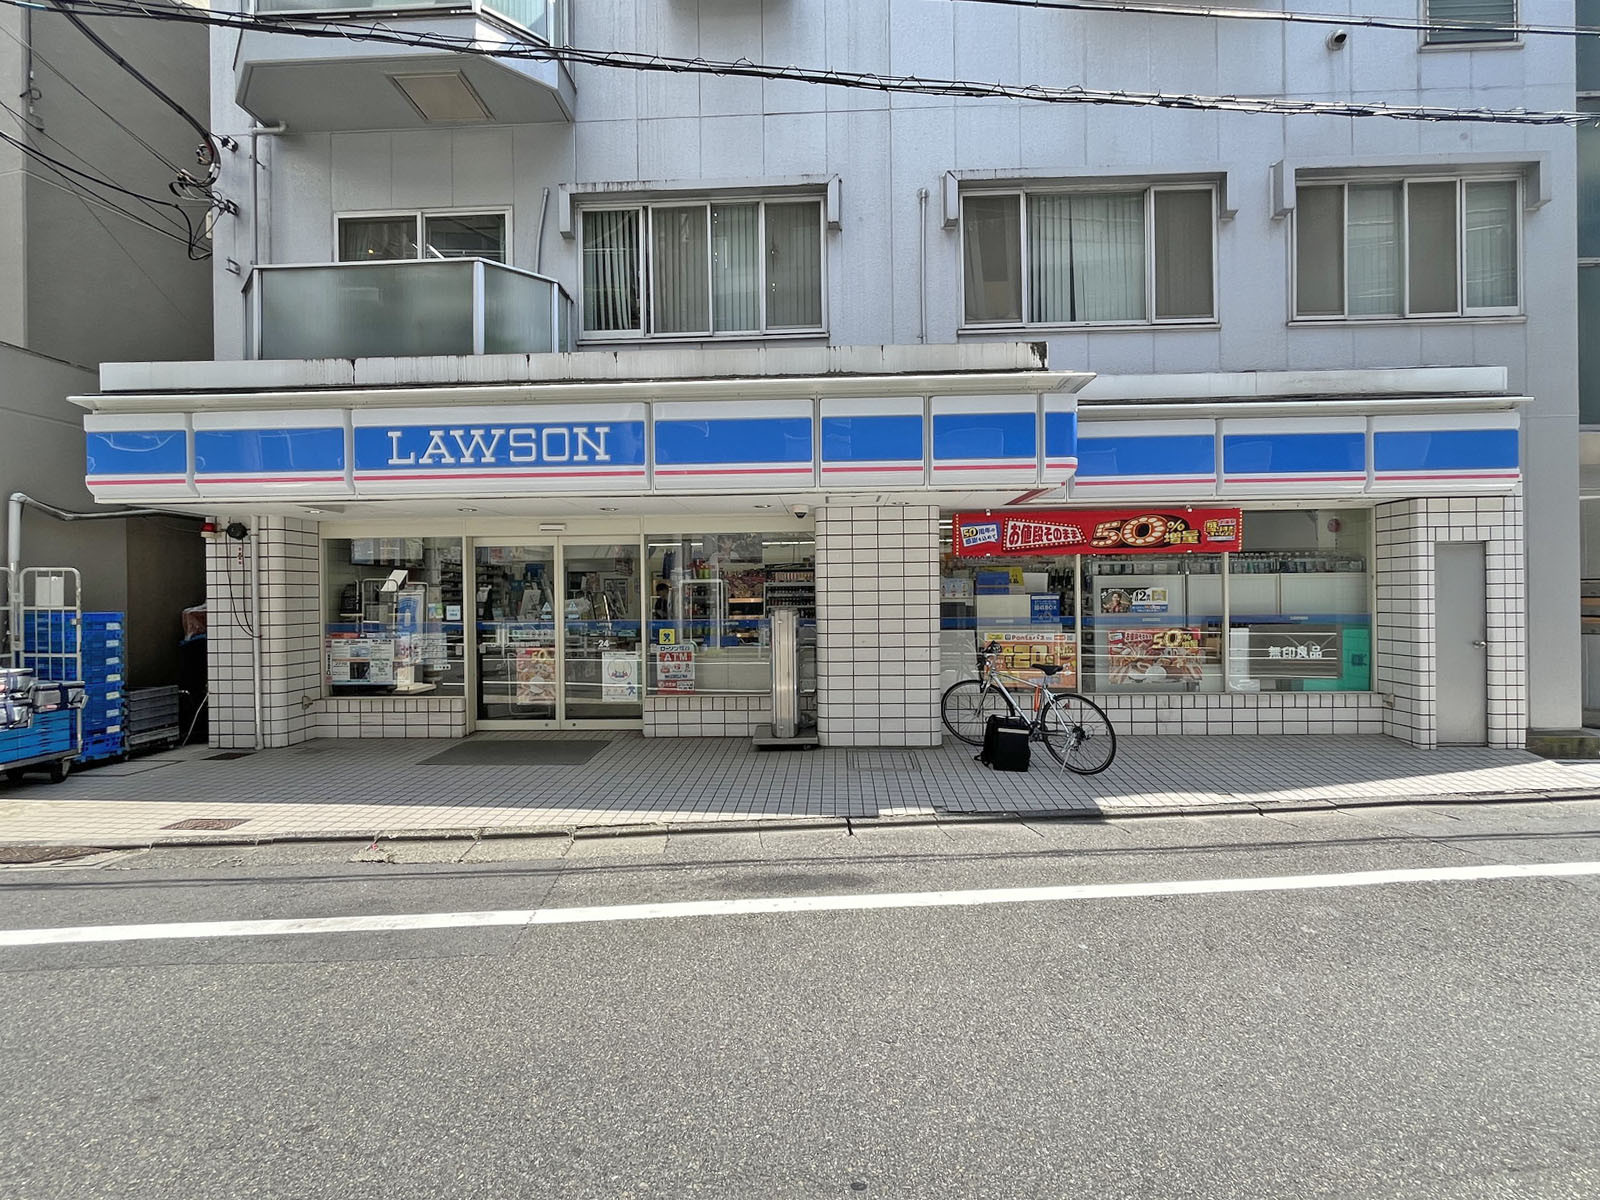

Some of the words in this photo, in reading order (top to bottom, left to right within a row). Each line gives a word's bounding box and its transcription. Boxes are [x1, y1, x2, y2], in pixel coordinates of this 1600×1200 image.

[387, 426, 611, 465] LAWSON
[1008, 522, 1079, 546] お値段そのまま
[1163, 529, 1200, 544] 増量
[598, 639, 610, 648] 24
[663, 653, 688, 661] ATM
[1268, 645, 1322, 659] 無印良品
